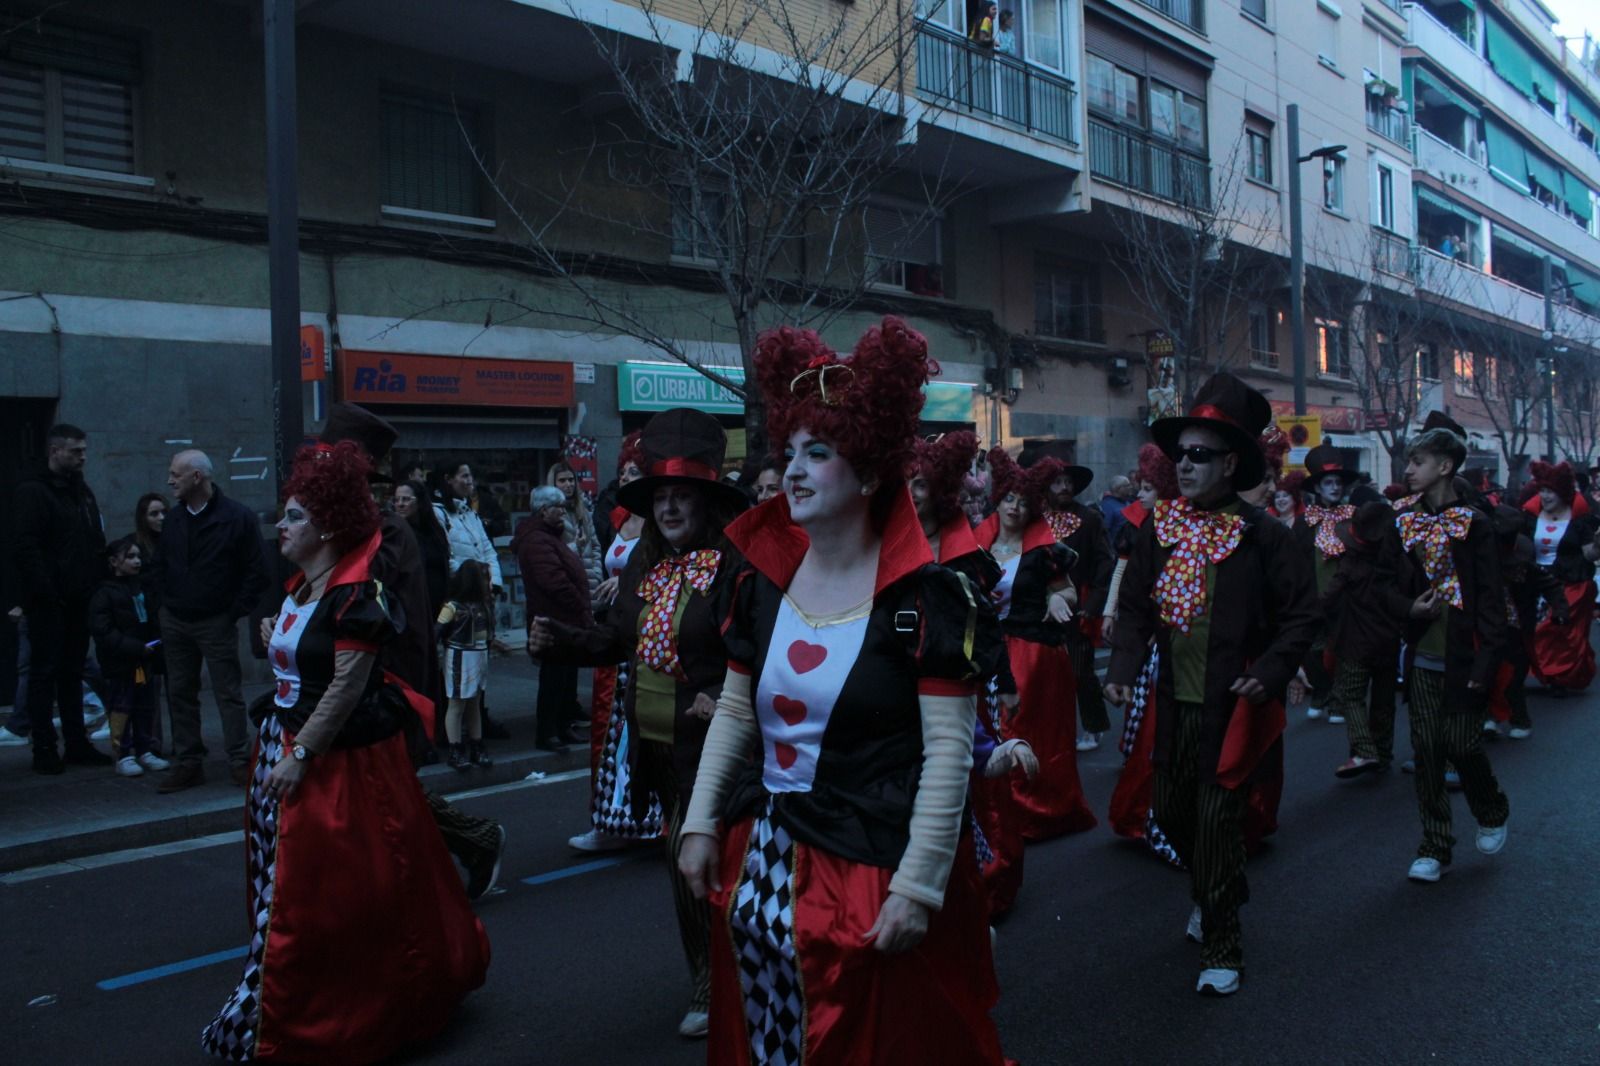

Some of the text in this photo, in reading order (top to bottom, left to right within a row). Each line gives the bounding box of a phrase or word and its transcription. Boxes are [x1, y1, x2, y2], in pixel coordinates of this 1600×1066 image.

[354, 360, 407, 393] Ria
[416, 375, 460, 385] MONEY
[476, 369, 516, 380] MASTER
[416, 385, 460, 394] TRANSFER
[659, 377, 707, 401] URBAN
